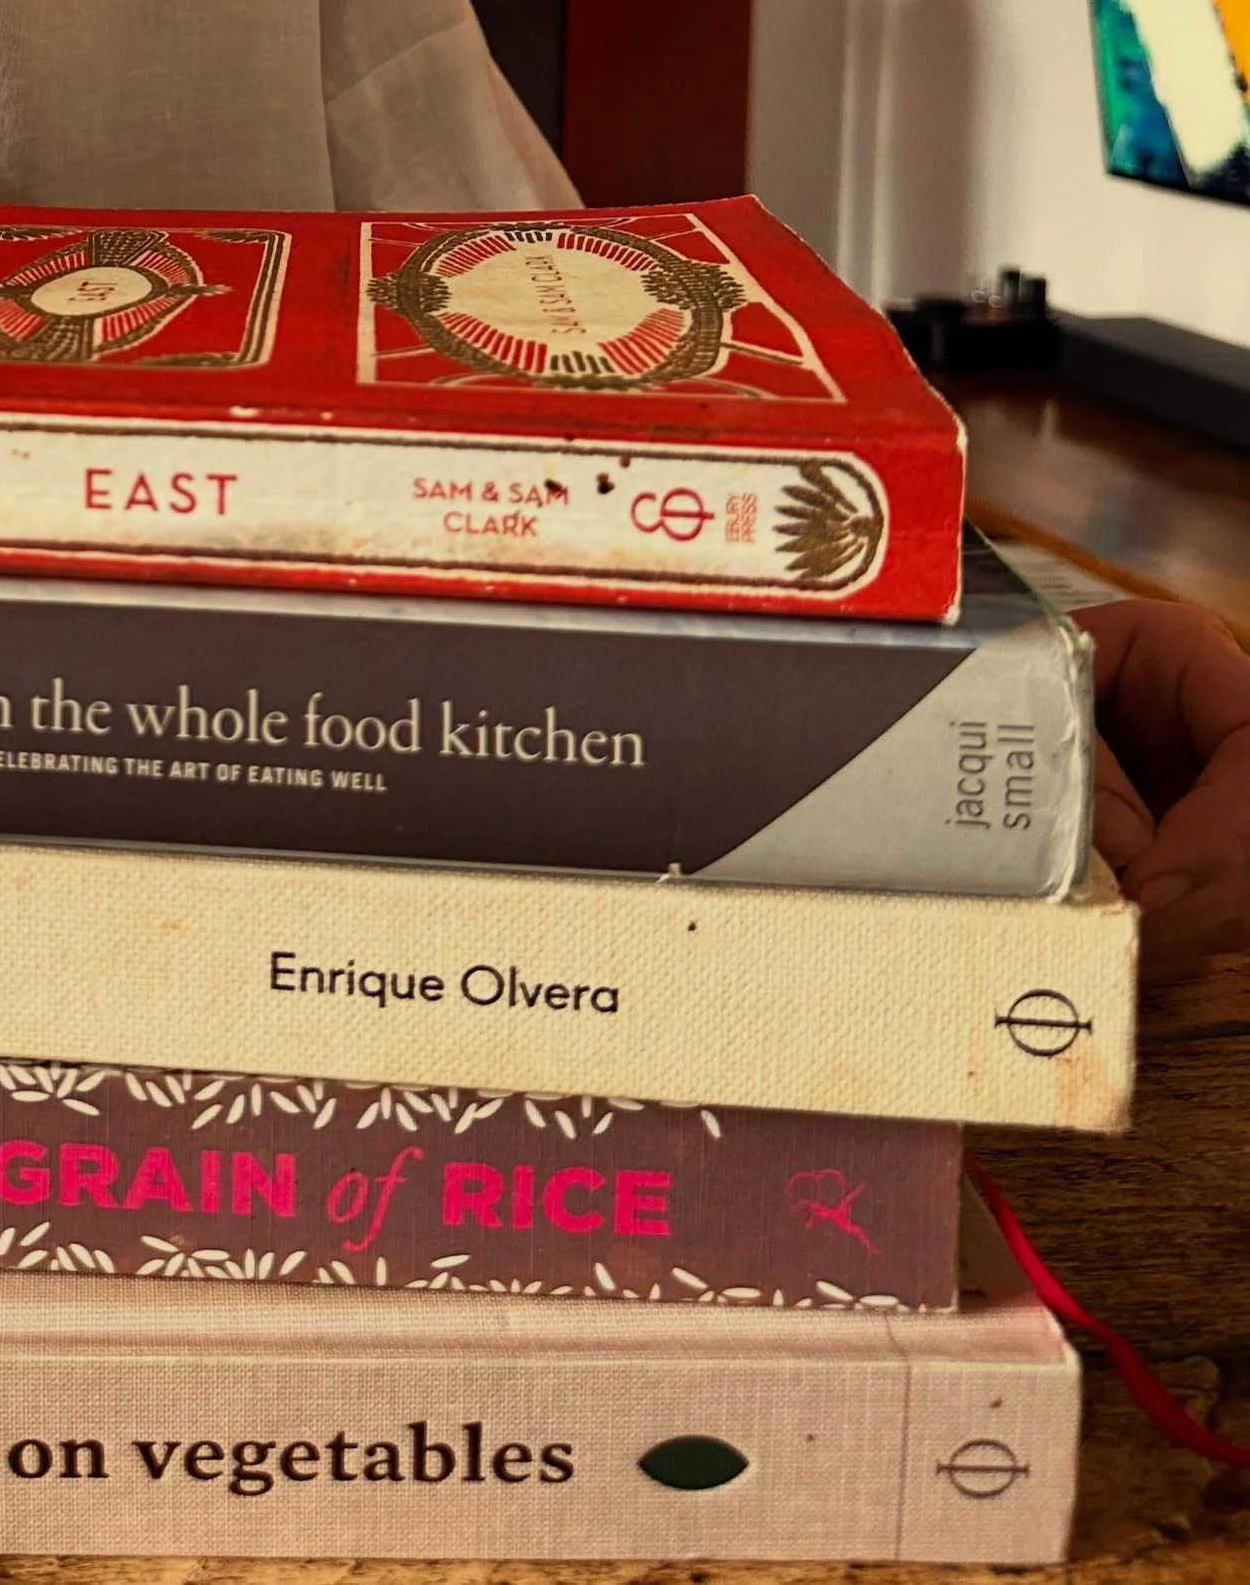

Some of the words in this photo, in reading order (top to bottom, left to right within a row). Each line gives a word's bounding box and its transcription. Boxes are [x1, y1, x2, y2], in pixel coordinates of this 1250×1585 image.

[85, 467, 238, 516] EAST
[413, 477, 473, 501] SAM
[481, 481, 500, 503] &
[509, 479, 570, 506] SAM
[443, 510, 538, 537] CLARK
[30, 677, 112, 734] the
[126, 684, 289, 744] whole
[303, 691, 424, 753] food
[439, 700, 646, 768] kitchen
[124, 757, 163, 778] THE
[169, 760, 212, 781] ART
[216, 763, 242, 783] OF
[248, 765, 323, 788] EATING
[331, 771, 388, 793] WELL
[945, 721, 994, 830] jacqui
[996, 724, 1035, 830] small
[269, 951, 445, 1007] Enrique
[460, 964, 621, 1014] Olvera
[325, 1146, 424, 1253] of
[442, 1160, 672, 1237] RICE
[7, 1436, 110, 1480] on
[133, 1419, 576, 1497] vegetables
